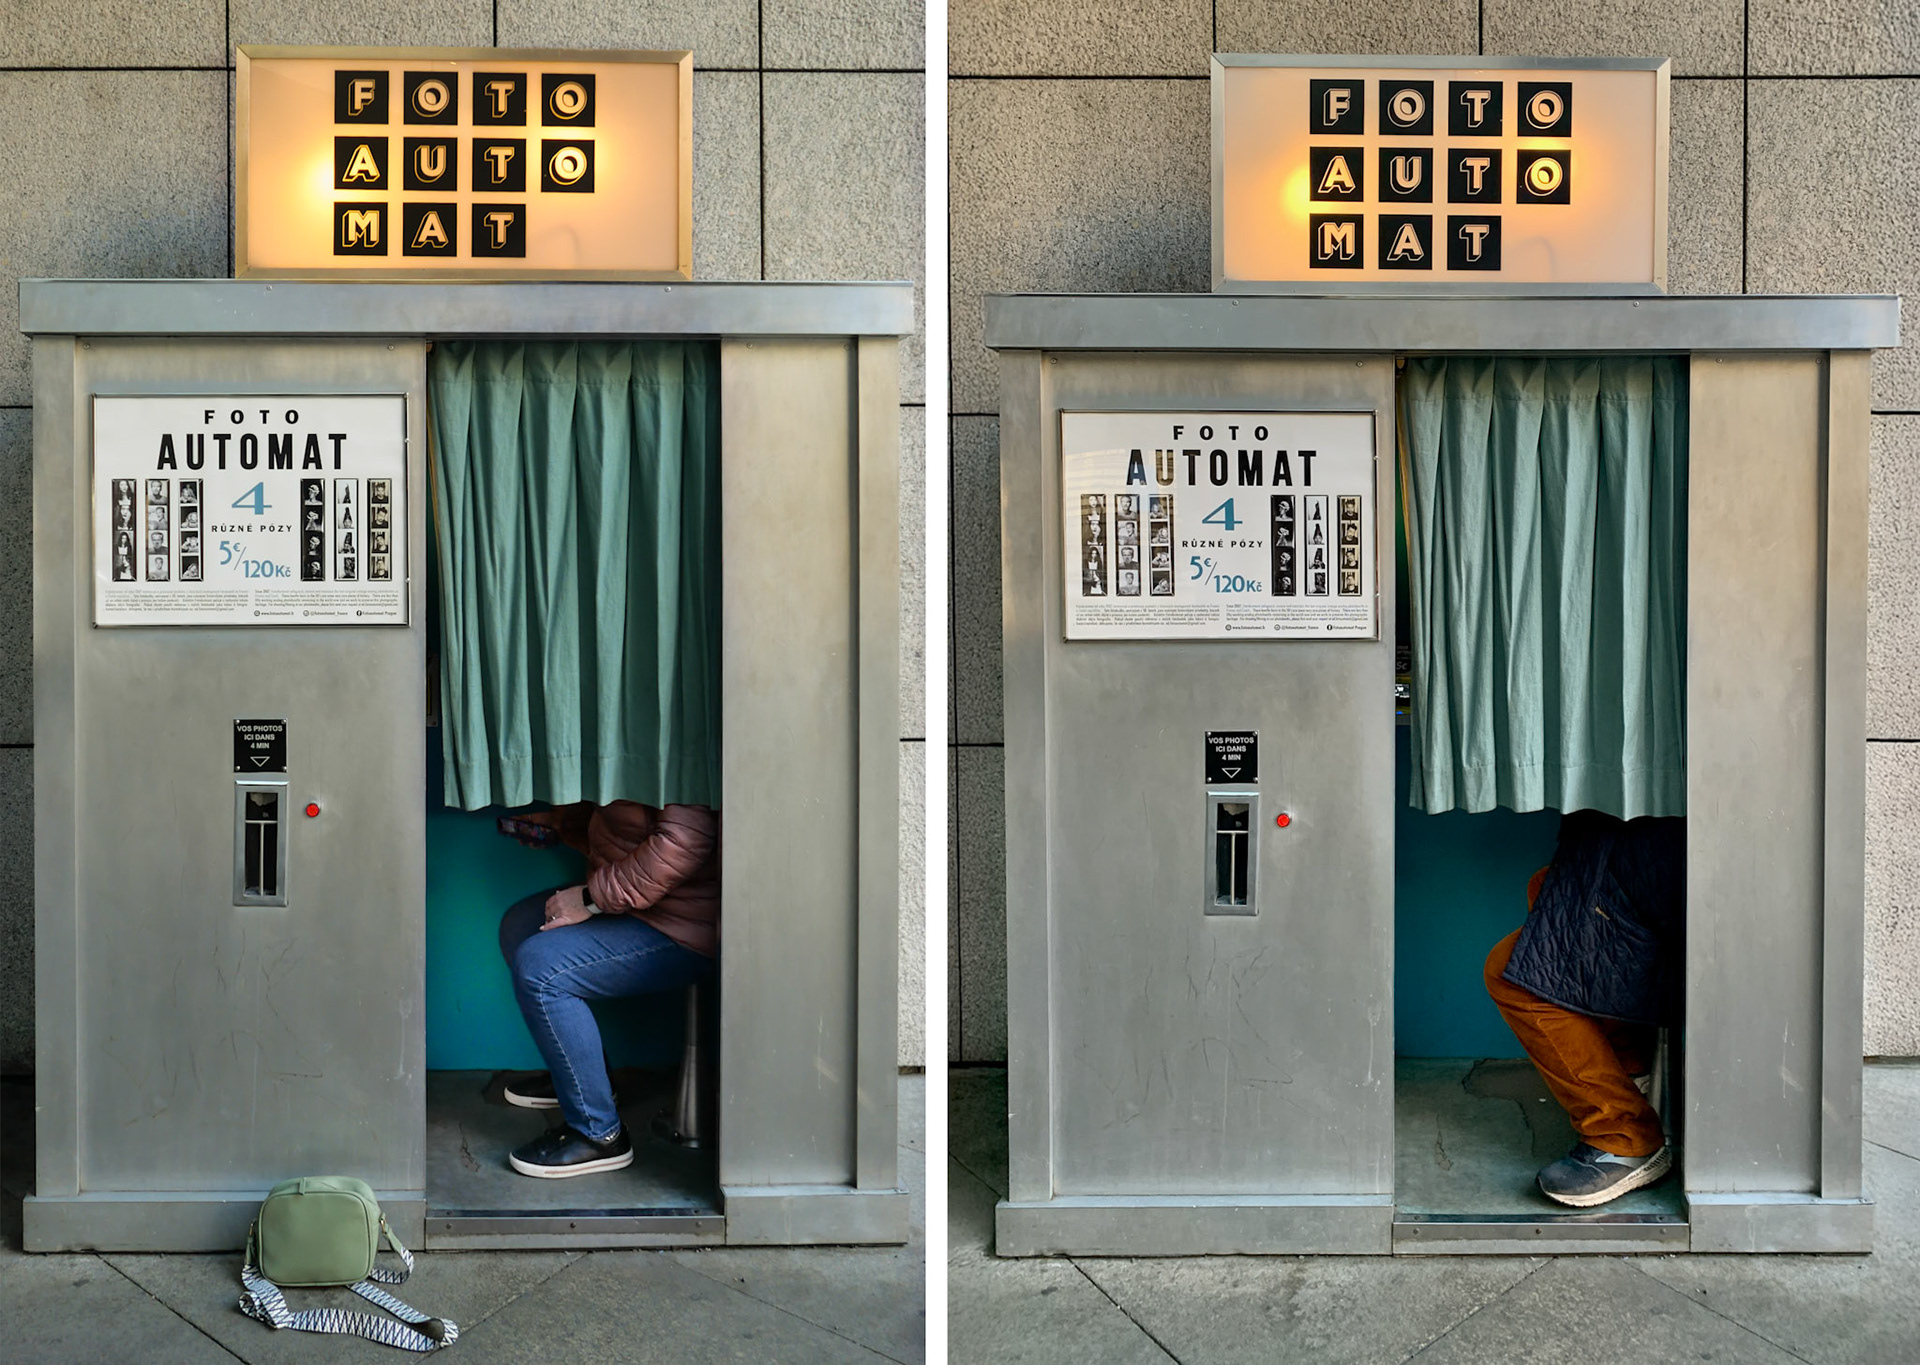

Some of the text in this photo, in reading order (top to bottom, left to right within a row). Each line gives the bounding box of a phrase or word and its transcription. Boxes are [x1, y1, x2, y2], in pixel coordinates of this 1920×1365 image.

[347, 78, 588, 120] FOTO
[1323, 87, 1565, 129] FOTO
[342, 143, 588, 186] AUTO
[1318, 155, 1564, 197] AUTO
[341, 209, 515, 249] MAT
[1317, 222, 1490, 262] MAT
[204, 409, 300, 425] FOTO
[1172, 425, 1270, 441] FOTO
[156, 433, 347, 470] AUTOMAT
[1126, 449, 1317, 487] AUTOMAT
[231, 481, 273, 515] 4
[1201, 497, 1243, 531] 4
